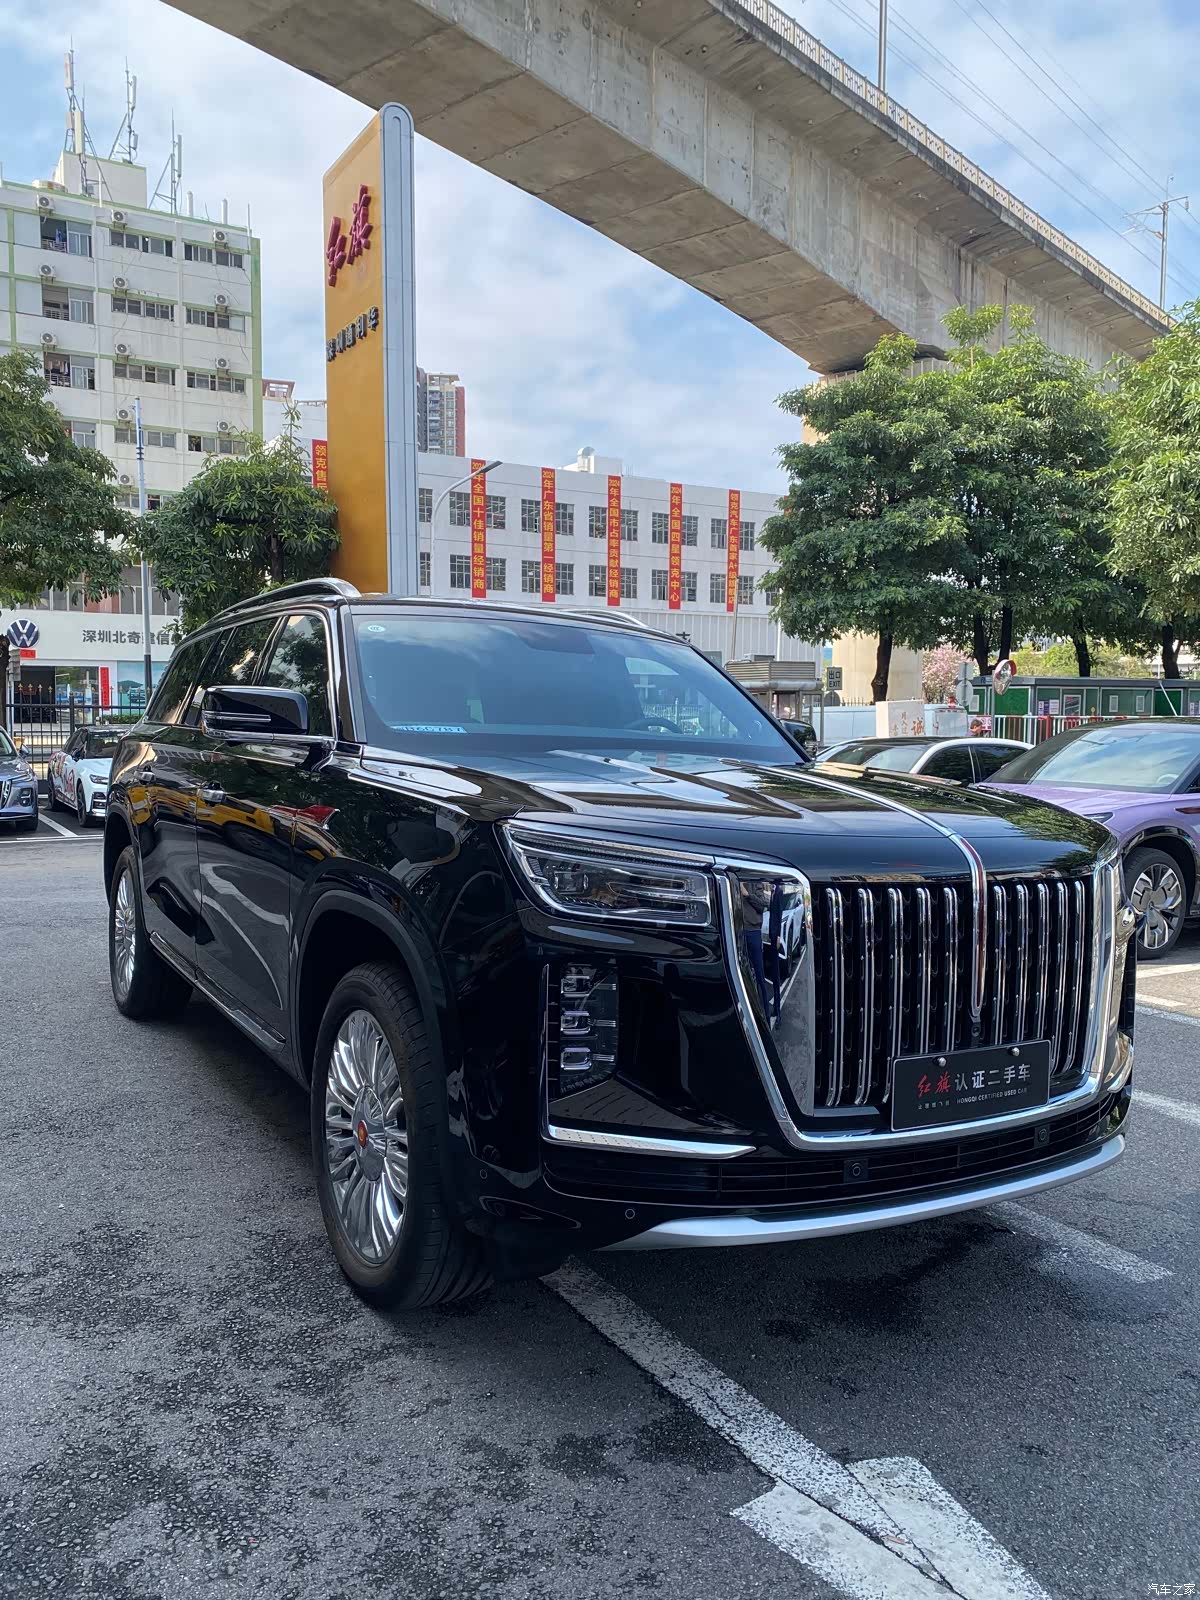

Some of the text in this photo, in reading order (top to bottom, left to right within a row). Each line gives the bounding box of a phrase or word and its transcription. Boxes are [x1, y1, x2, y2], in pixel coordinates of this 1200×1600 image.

[326, 184, 373, 287] 红旗
[828, 670, 841, 679] 出口
[828, 680, 841, 688] EXIT
[956, 1087, 1028, 1105] HONGQI CERTIFIED USED CAR
